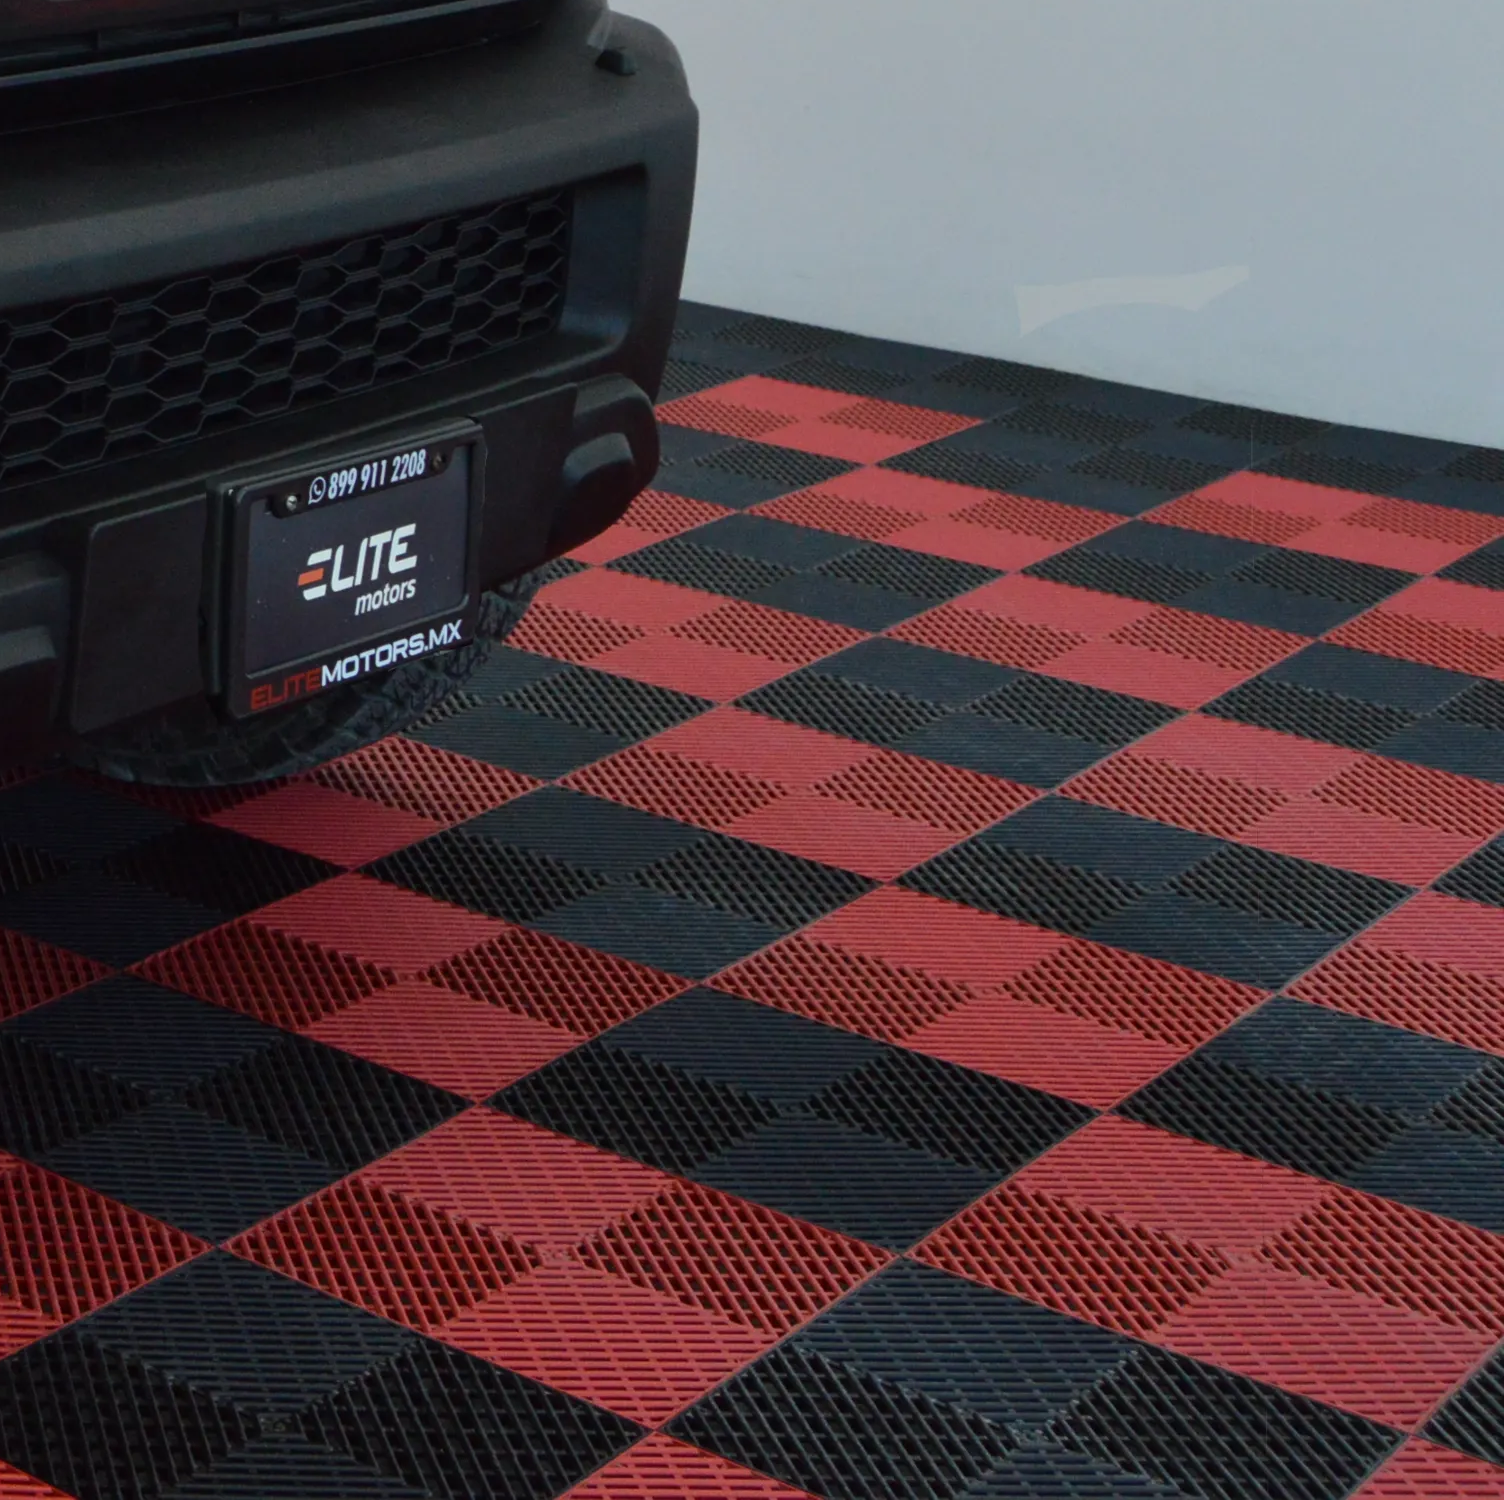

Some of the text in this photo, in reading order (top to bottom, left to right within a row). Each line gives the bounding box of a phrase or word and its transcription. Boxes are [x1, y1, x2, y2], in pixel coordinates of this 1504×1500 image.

[327, 448, 426, 500] 899 911 2208
[297, 522, 418, 601] ELITE
[354, 578, 416, 616] motors
